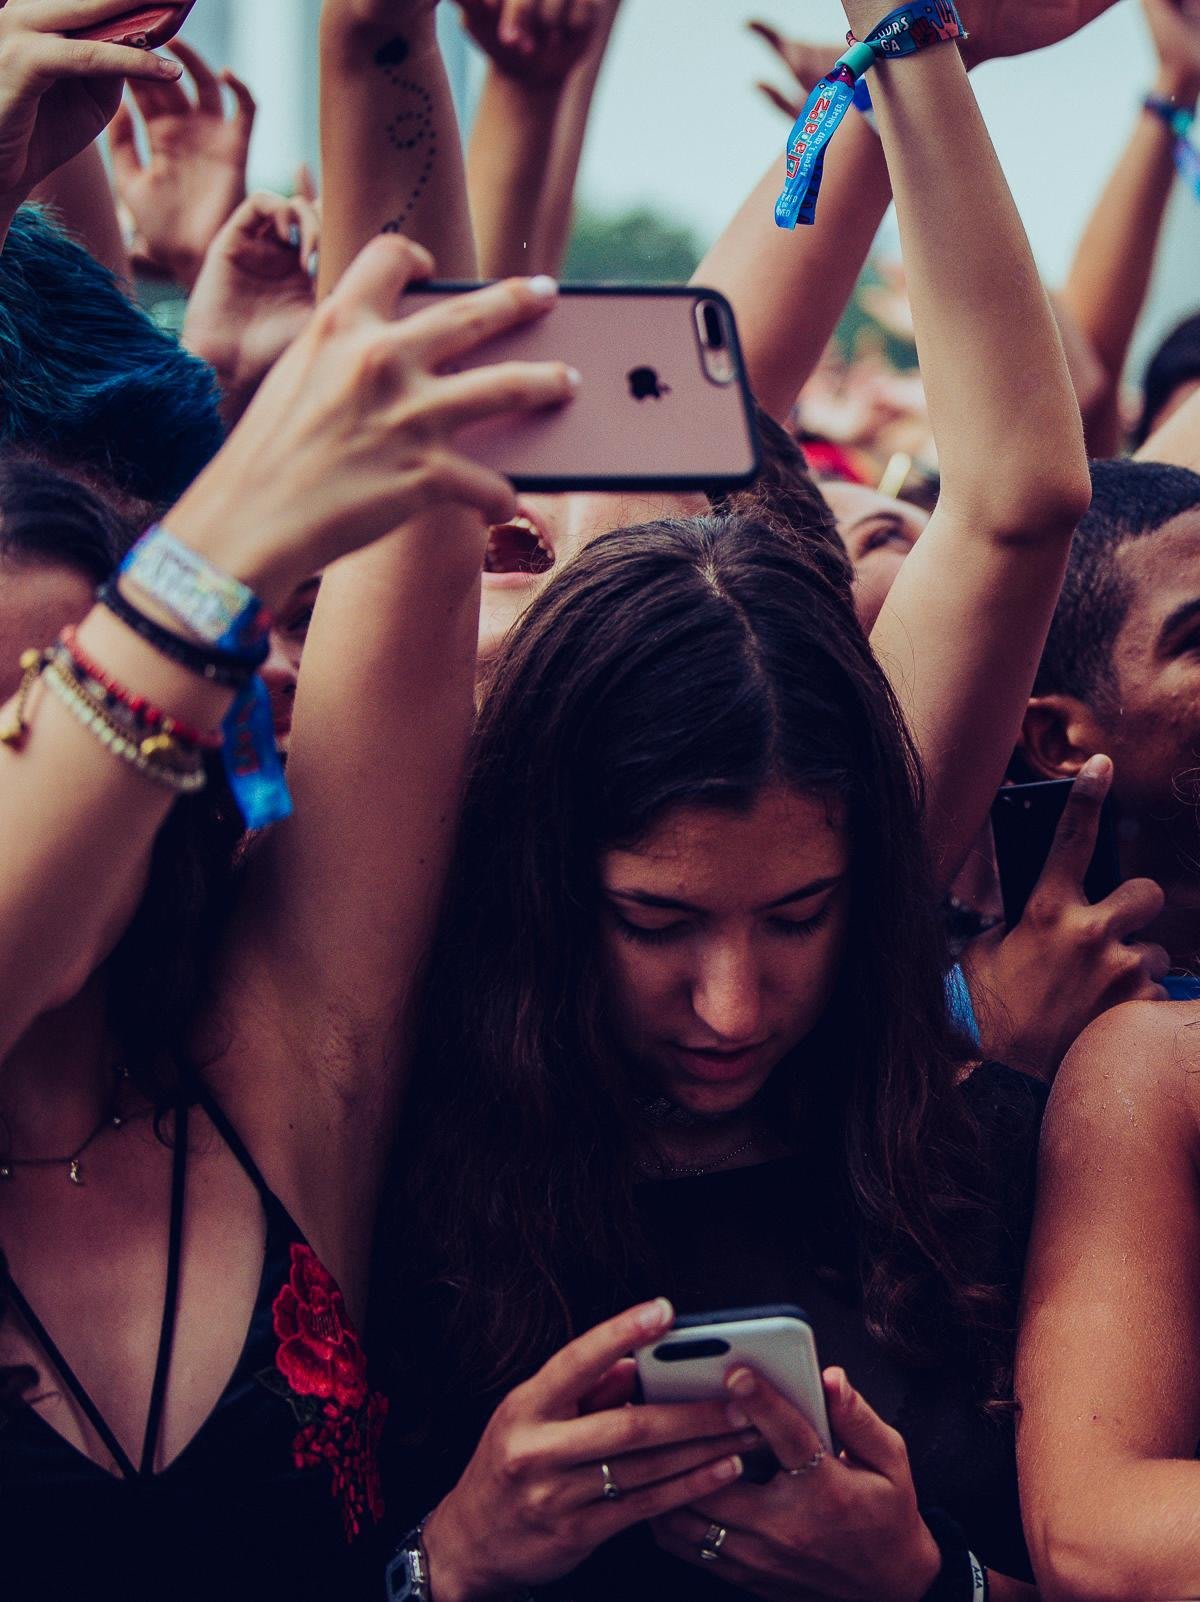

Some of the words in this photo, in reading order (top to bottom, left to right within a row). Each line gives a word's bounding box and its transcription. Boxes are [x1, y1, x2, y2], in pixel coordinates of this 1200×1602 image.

[880, 39, 901, 52] GA
[800, 151, 813, 177] August
[814, 132, 826, 145] 2017
